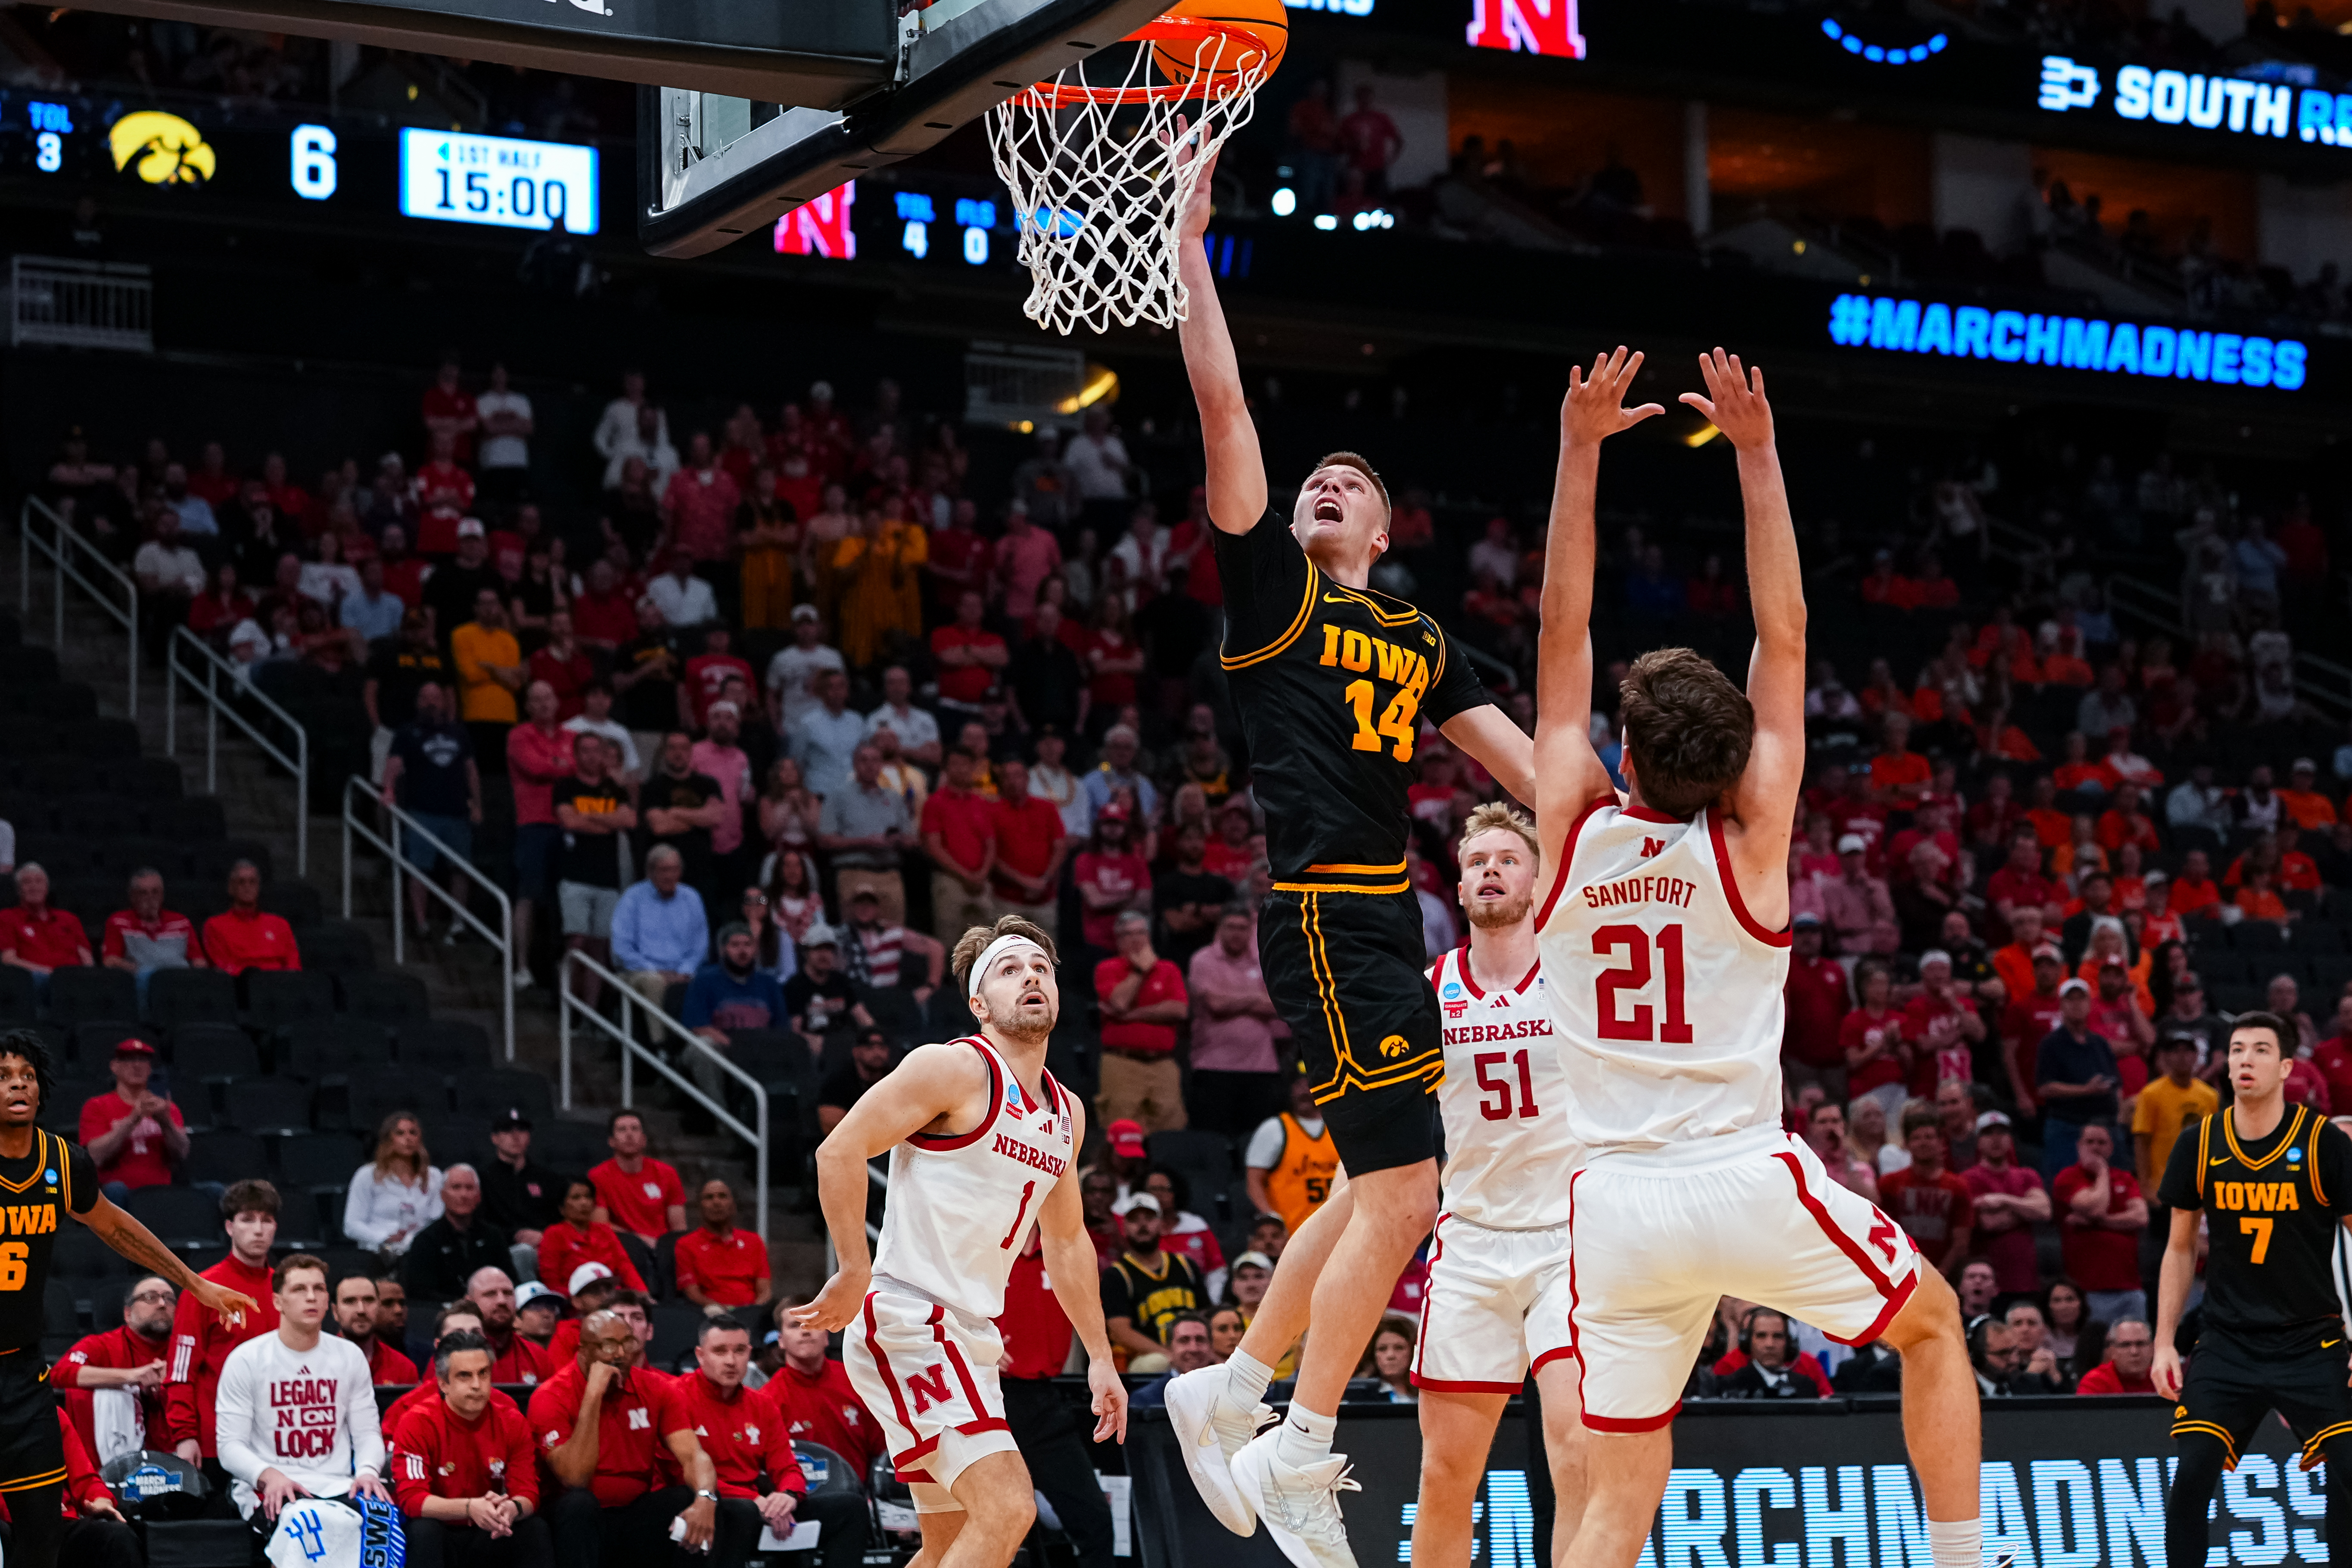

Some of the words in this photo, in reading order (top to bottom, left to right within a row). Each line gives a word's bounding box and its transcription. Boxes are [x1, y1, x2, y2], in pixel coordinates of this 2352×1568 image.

[29, 102, 73, 134] TOL
[2114, 65, 2292, 138] SOUTH
[36, 132, 62, 172] 3
[291, 124, 337, 200] 6
[458, 145, 489, 165] 1ST
[497, 151, 541, 170] HALF
[435, 170, 567, 219] 15:00
[903, 220, 928, 258] 4
[963, 227, 988, 264] 0
[1829, 294, 2308, 390] #MARCHMADNESS
[1319, 624, 1429, 703] IOWA
[1345, 679, 1414, 762] 14
[1640, 837, 1665, 857] N
[1583, 877, 1696, 908] SANDFORT
[1591, 924, 1693, 1044] 21
[1474, 1049, 1539, 1121] 51
[1006, 1105, 1022, 1118] GRADUATE
[1306, 1178, 1333, 1203] 5
[2214, 1182, 2299, 1211] IOWA
[1000, 1180, 1036, 1250] 1
[2240, 1217, 2274, 1264] 7
[0, 1241, 29, 1291] 6
[271, 1379, 337, 1407] LEGACY
[904, 1363, 954, 1417] N
[278, 1409, 294, 1428] N
[302, 1409, 334, 1425] ON
[628, 1407, 650, 1430] N
[274, 1428, 336, 1459] LOCK
